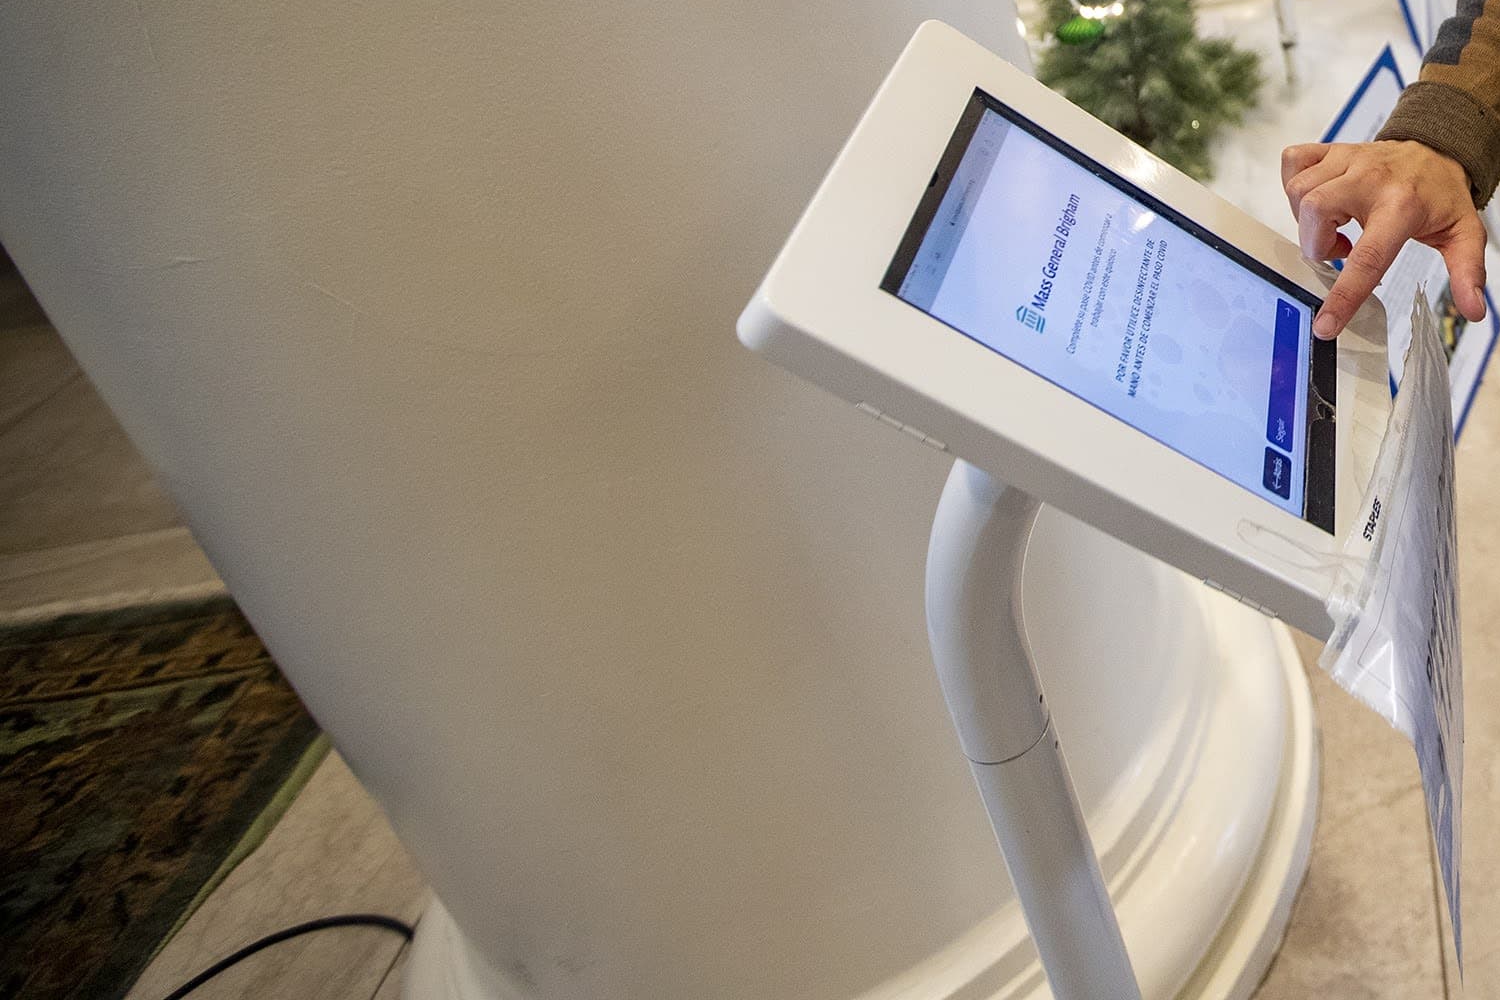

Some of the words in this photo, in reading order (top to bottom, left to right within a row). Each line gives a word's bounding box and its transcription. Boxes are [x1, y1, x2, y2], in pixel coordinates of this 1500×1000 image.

[1031, 276, 1053, 311] Mass
[1042, 235, 1066, 279] General
[1056, 193, 1081, 238] Brigham
[1093, 244, 1102, 255] de
[1145, 237, 1154, 249] DE
[1156, 239, 1167, 262] COVID
[1089, 253, 1100, 274] antes
[1152, 260, 1163, 281] PASO
[1082, 270, 1095, 294] COVID
[1100, 272, 1110, 287] este
[1132, 248, 1151, 306] DESINFECTANTE
[1150, 279, 1159, 291] EL
[1079, 292, 1091, 312] pase
[1098, 286, 1106, 300] con
[1089, 298, 1104, 328] trabajar
[1125, 304, 1139, 337] UTILICE
[1141, 289, 1157, 332] COMENZAR
[1066, 317, 1084, 355] Complete
[1139, 331, 1148, 344] DE
[1119, 335, 1132, 364] FAVOR
[1133, 343, 1146, 372] ANTES
[1115, 361, 1126, 383] POR
[1127, 371, 1140, 398] MANO
[1275, 416, 1286, 444] Seguir
[1363, 496, 1381, 541] STAPLES
